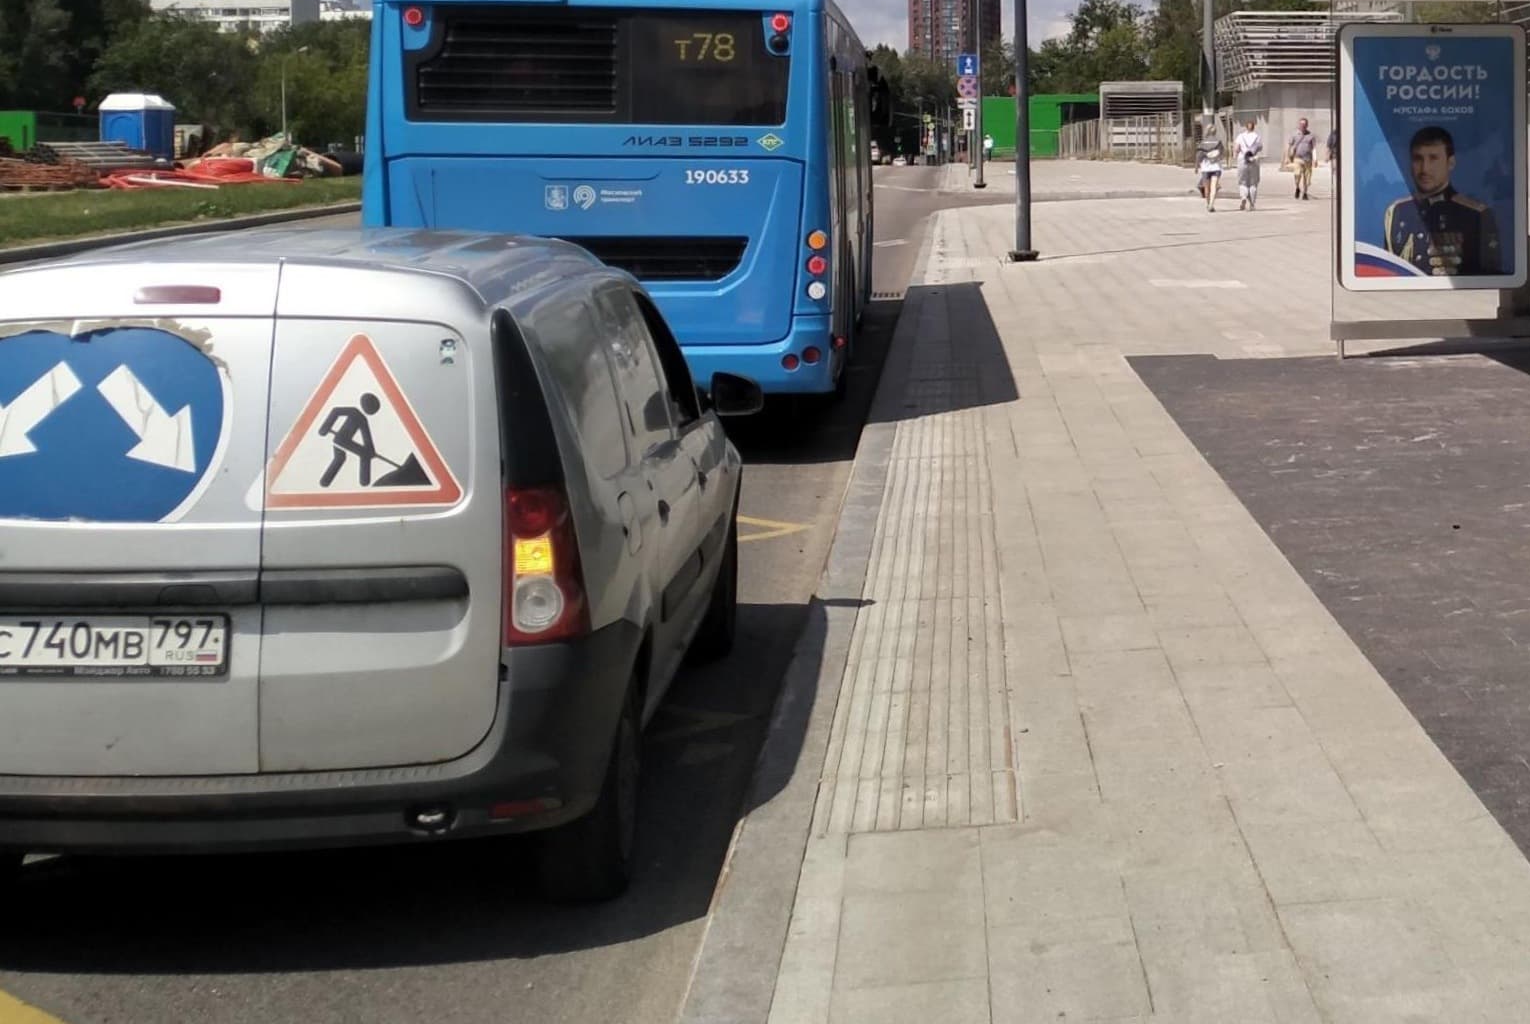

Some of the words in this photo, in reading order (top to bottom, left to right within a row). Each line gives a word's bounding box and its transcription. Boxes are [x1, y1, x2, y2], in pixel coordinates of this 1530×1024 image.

[1378, 65, 1488, 82] ГОРДОСТЬ
[1385, 84, 1480, 100] РОССИИ!
[688, 136, 749, 147] 5292
[684, 169, 750, 185] 190633
[153, 620, 215, 649] 797
[165, 650, 195, 662] RUS
